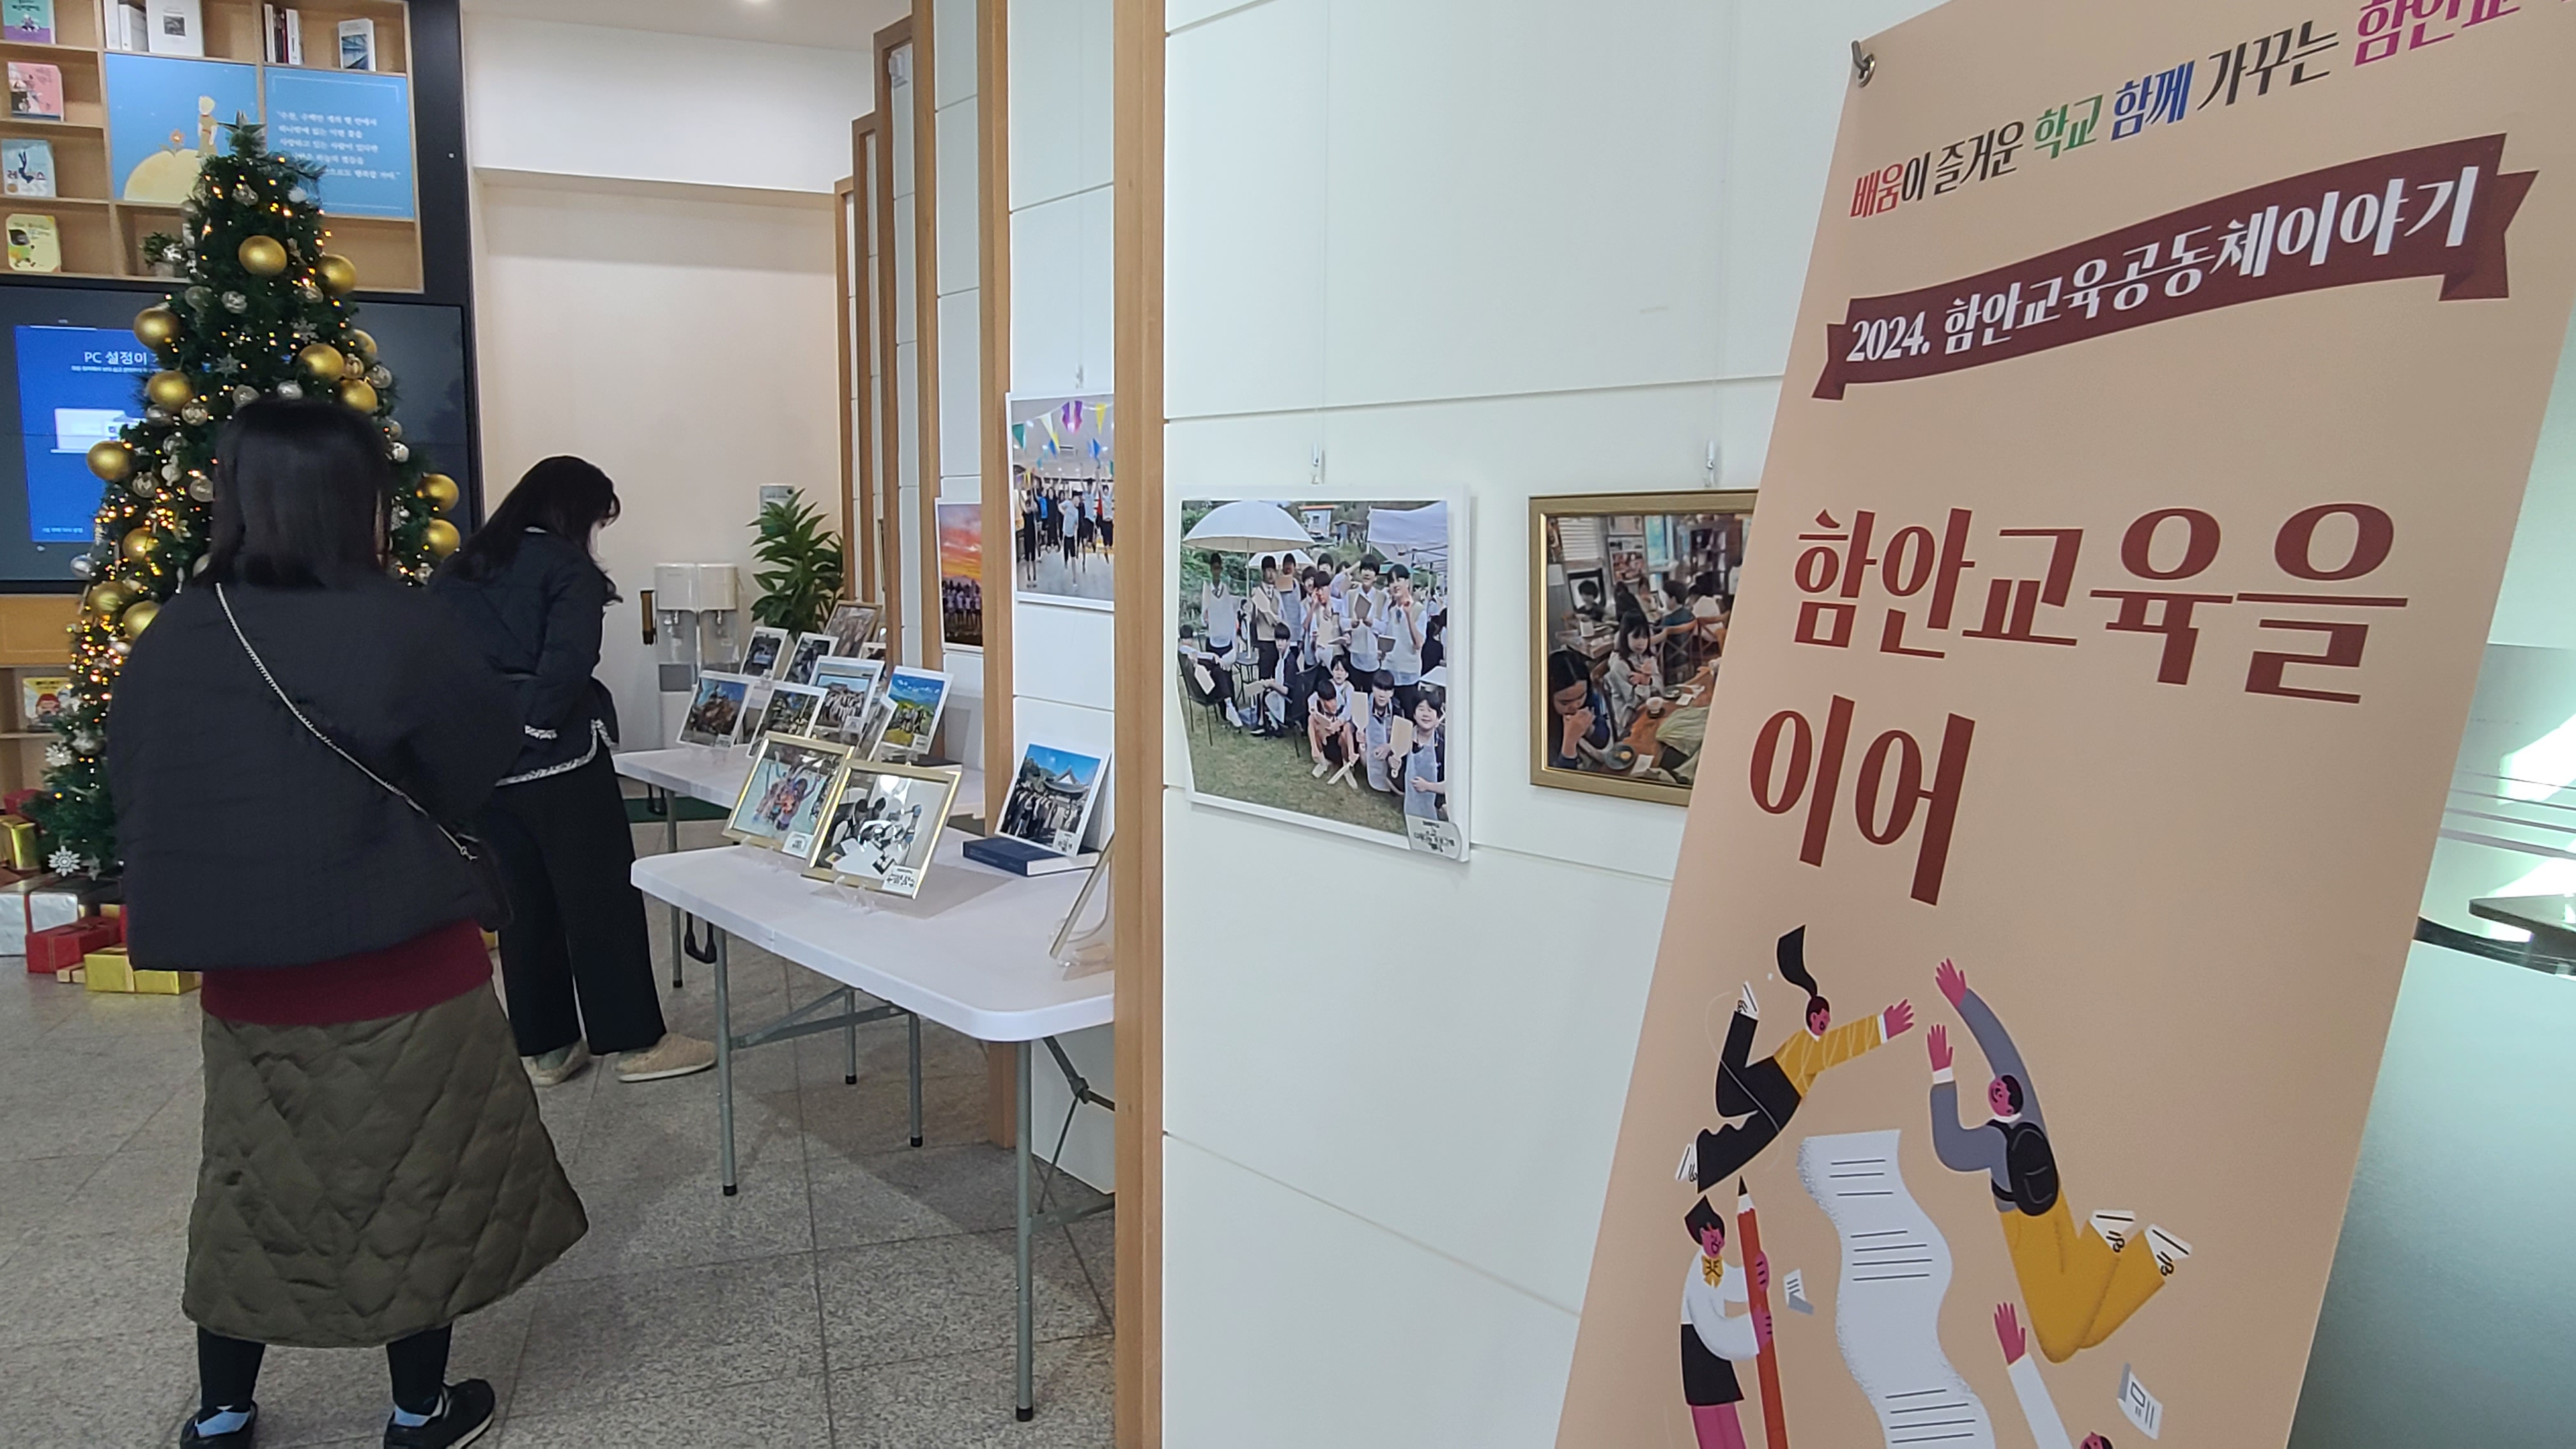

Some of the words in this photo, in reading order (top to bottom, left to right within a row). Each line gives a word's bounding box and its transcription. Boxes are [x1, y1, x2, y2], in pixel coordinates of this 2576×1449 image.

[1850, 151, 1931, 218] 배움이
[1933, 121, 2025, 196] 즐거운
[2034, 94, 2104, 160] 학교
[2110, 59, 2195, 142] 함께
[2197, 20, 2340, 111] 가꾸는
[84, 351, 102, 364] PC
[105, 351, 147, 366] 설정이
[1845, 310, 1932, 364] 2024.
[1943, 165, 2481, 356] 함안교육공동체이야기
[1794, 502, 2409, 705] 함안교육을
[1749, 694, 1976, 907] 이어
